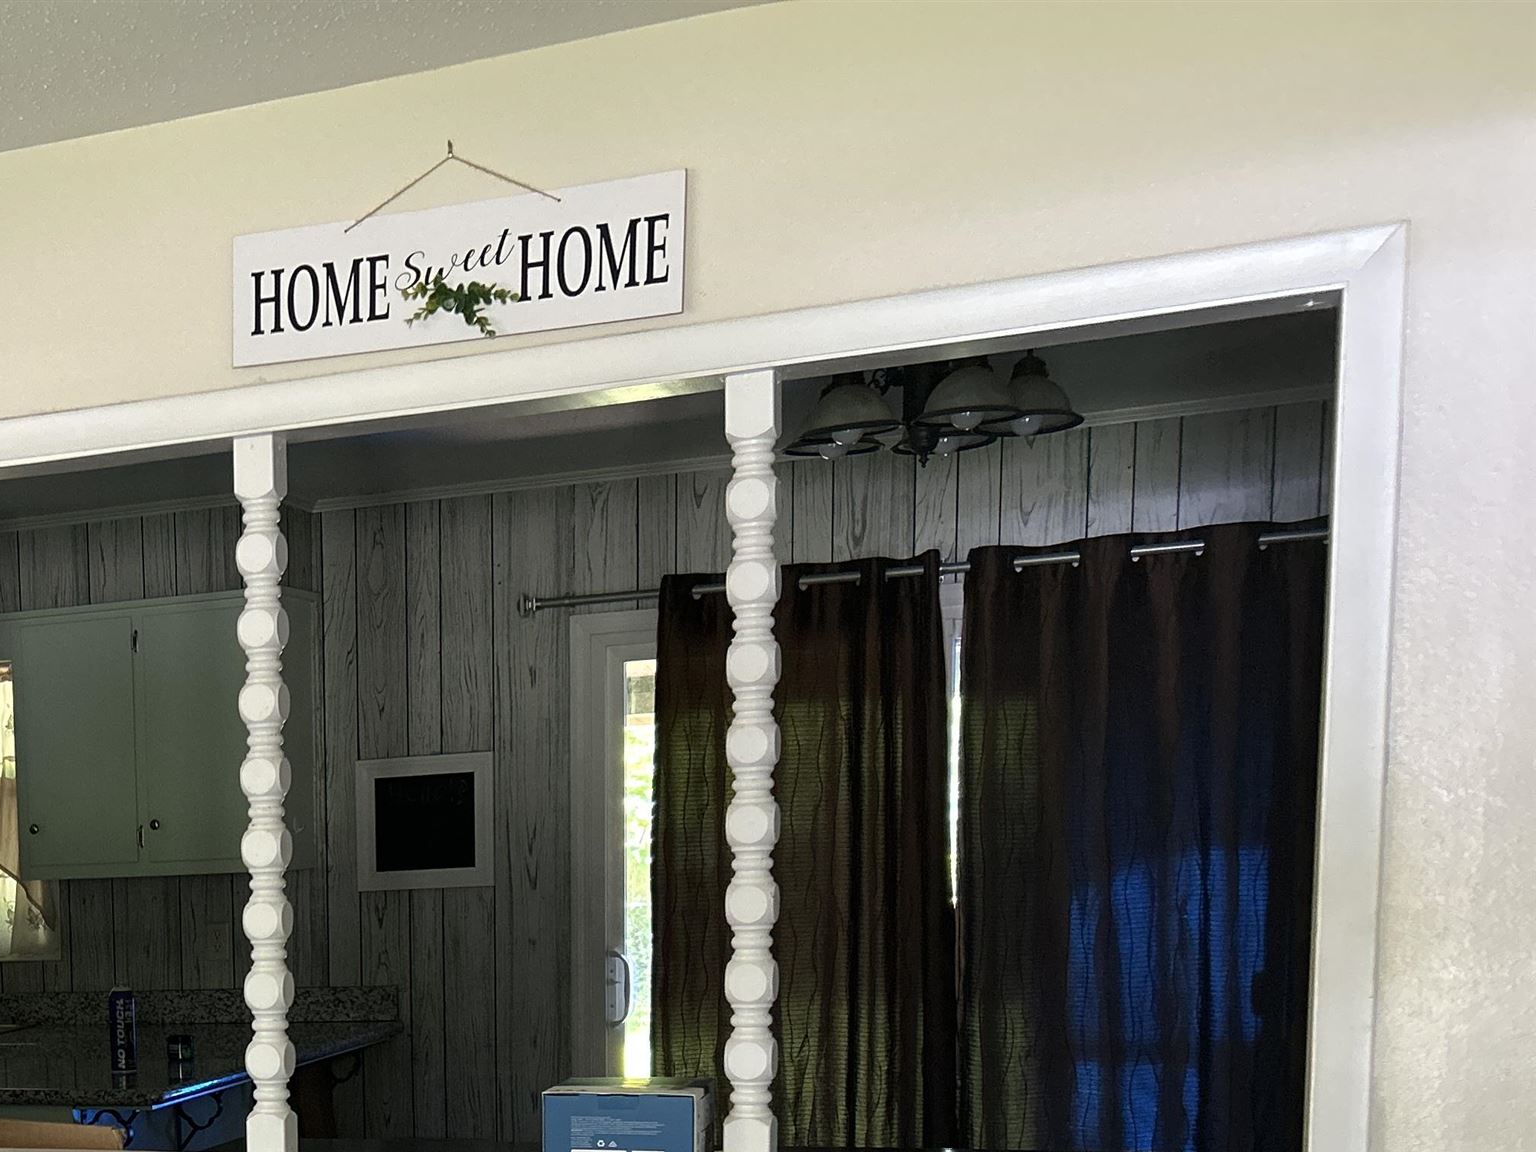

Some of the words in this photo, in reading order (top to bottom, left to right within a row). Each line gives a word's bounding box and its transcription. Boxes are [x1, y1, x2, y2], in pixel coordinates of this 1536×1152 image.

[251, 254, 390, 336] HOME
[395, 228, 515, 292] Sweet
[517, 213, 670, 302] HOME
[116, 998, 126, 1047] TOUCH
[117, 1049, 127, 1069] NO
